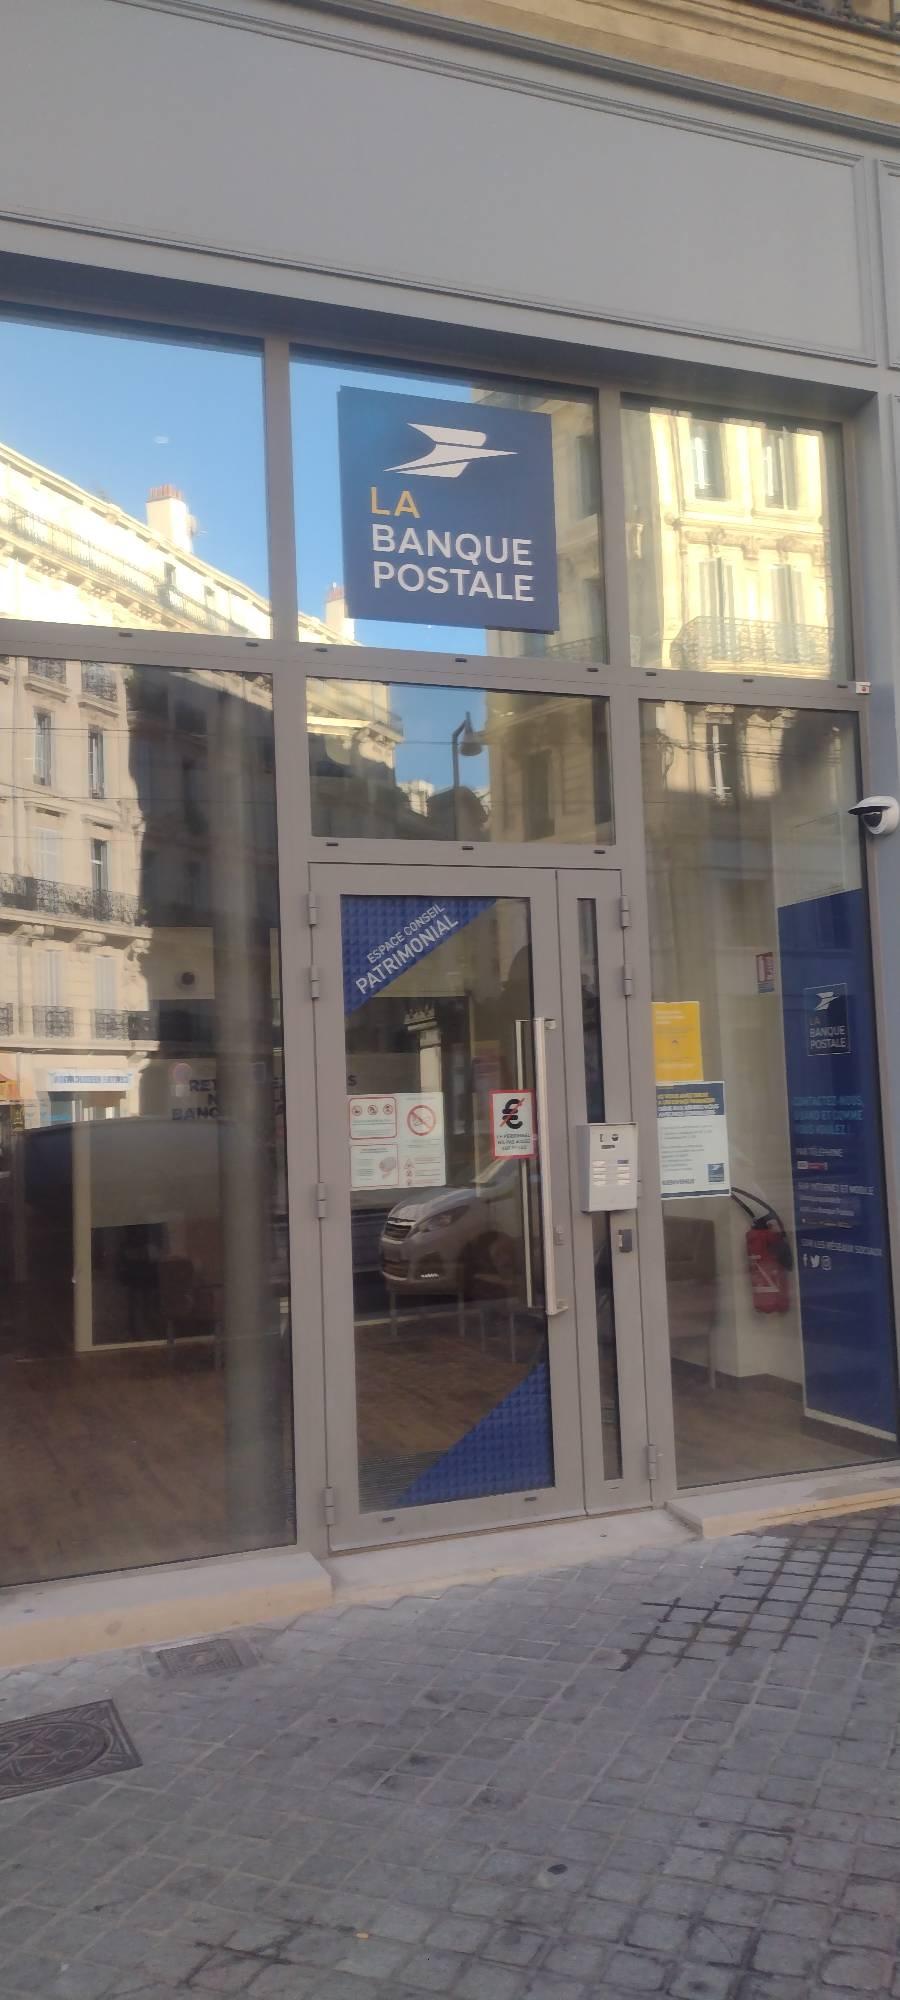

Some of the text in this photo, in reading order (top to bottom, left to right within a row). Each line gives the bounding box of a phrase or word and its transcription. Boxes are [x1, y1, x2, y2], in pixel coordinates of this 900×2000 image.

[370, 486, 420, 518] LA
[371, 523, 533, 566] BANQUE
[373, 560, 535, 602] POSTALE
[366, 903, 446, 964] ESPACE CONSEIL
[355, 915, 459, 995] PATRIMONIAL
[809, 1016, 821, 1025] LA
[809, 1025, 846, 1038] BANQUE
[810, 1037, 847, 1049] POSTALE
